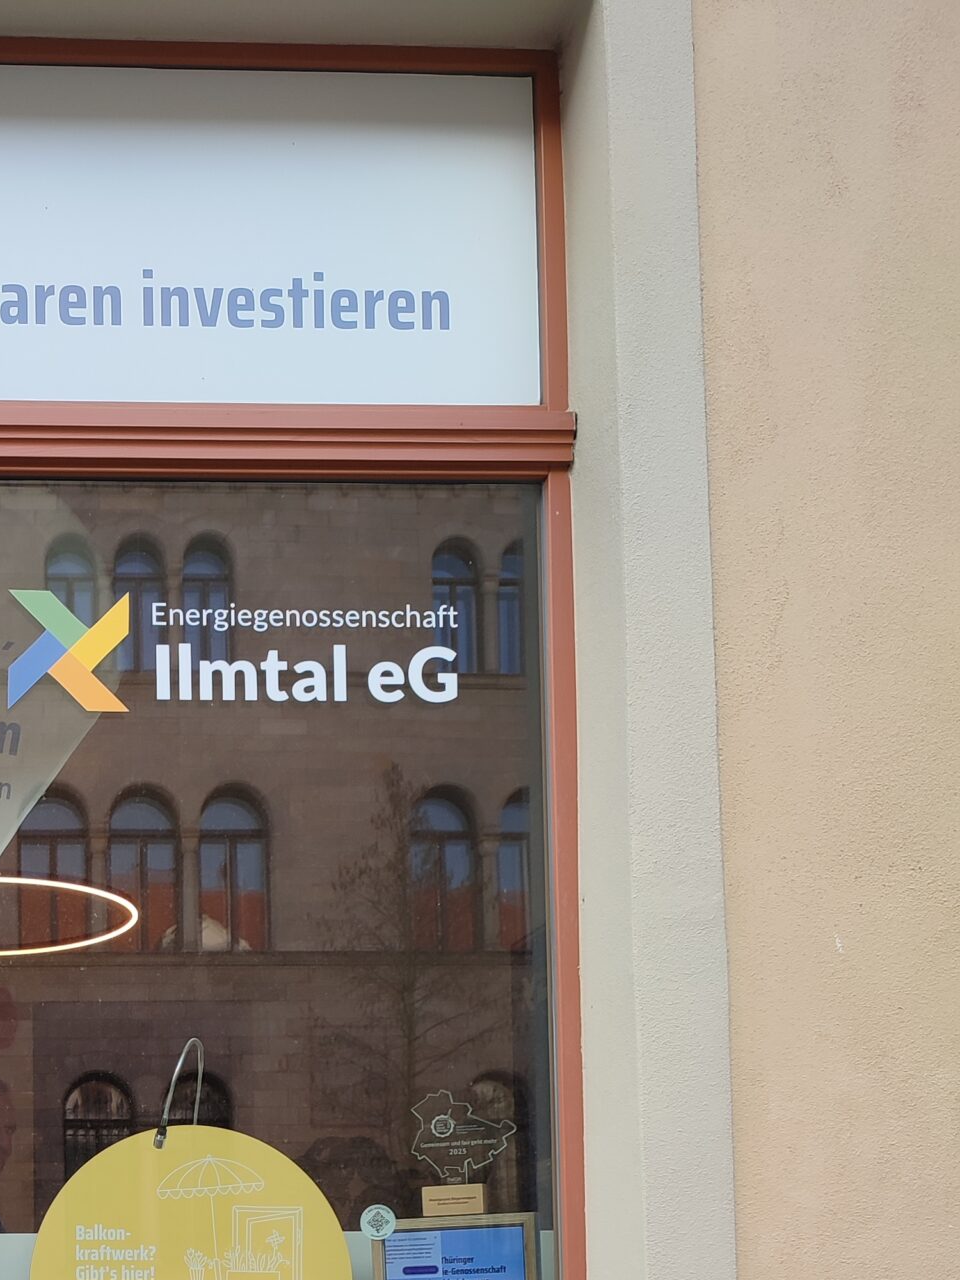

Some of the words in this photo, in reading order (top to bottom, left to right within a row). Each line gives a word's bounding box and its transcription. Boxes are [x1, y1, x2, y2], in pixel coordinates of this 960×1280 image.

[142, 269, 451, 331] investieren
[151, 602, 458, 632] Energiegenossenschaft
[155, 642, 348, 702] Ilmtal
[367, 645, 458, 704] eG
[448, 1147, 468, 1156] 2025
[75, 1224, 132, 1241] Balkon-
[75, 1244, 157, 1261] kraftwerk?
[75, 1264, 118, 1280] Gibt's
[121, 1264, 156, 1280] hier!
